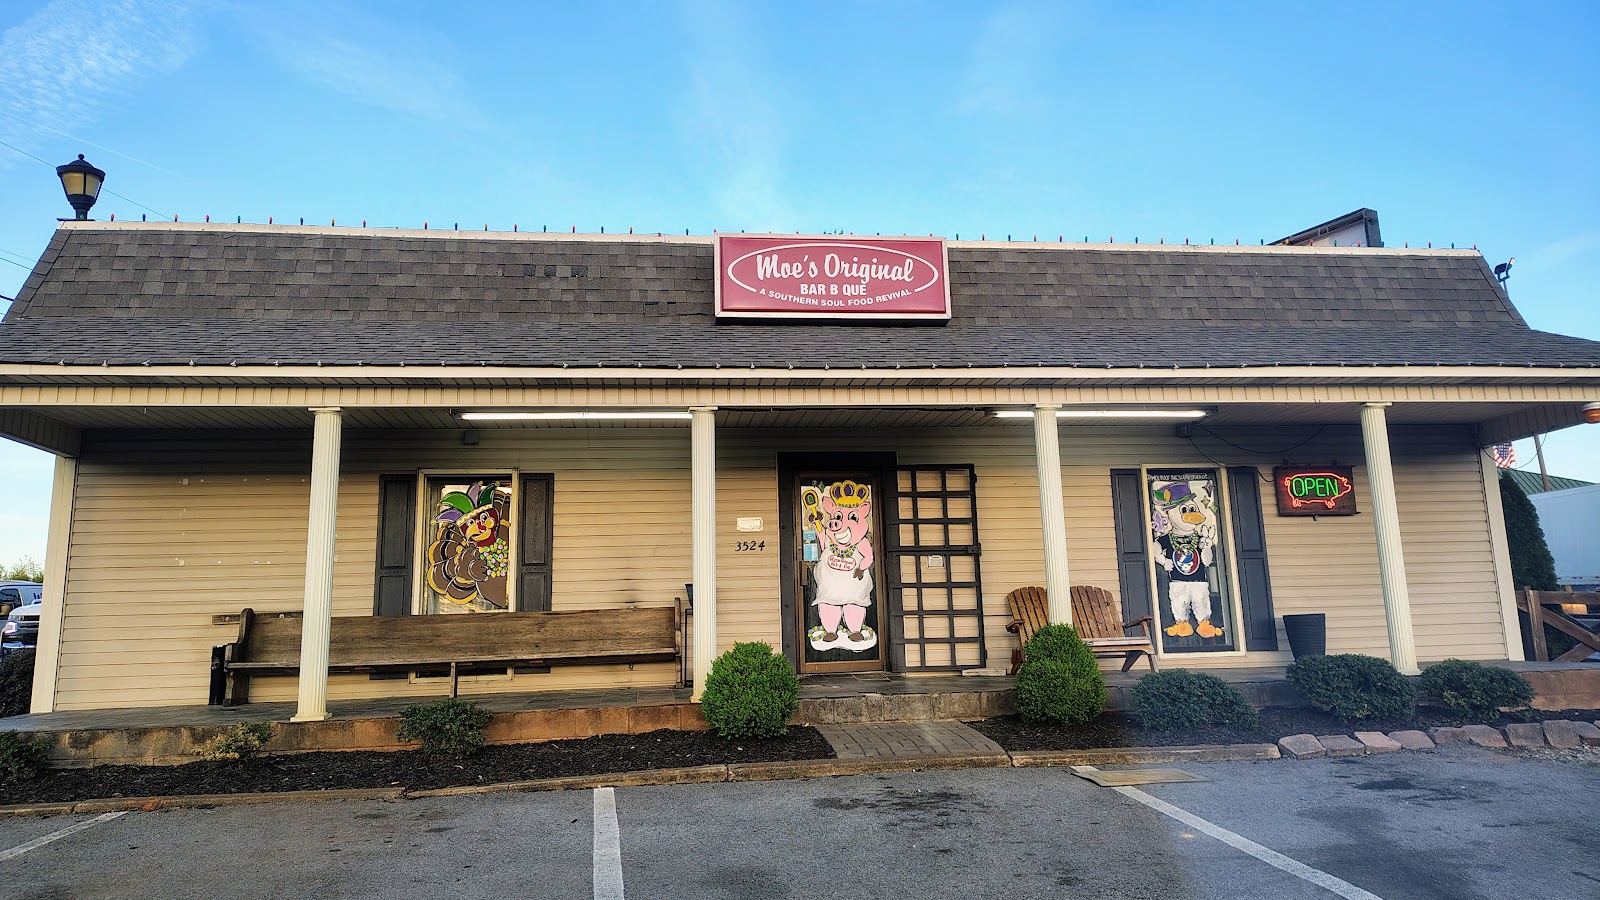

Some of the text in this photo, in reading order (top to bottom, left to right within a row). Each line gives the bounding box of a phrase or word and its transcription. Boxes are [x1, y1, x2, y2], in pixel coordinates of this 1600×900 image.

[756, 253, 915, 284] Moe's Original
[759, 288, 912, 307] A SOUTHERN SOUL FOOD REVIVAL
[800, 283, 867, 296] BAR B QUE
[1292, 477, 1339, 497] OPEN
[735, 540, 765, 552] 3524
